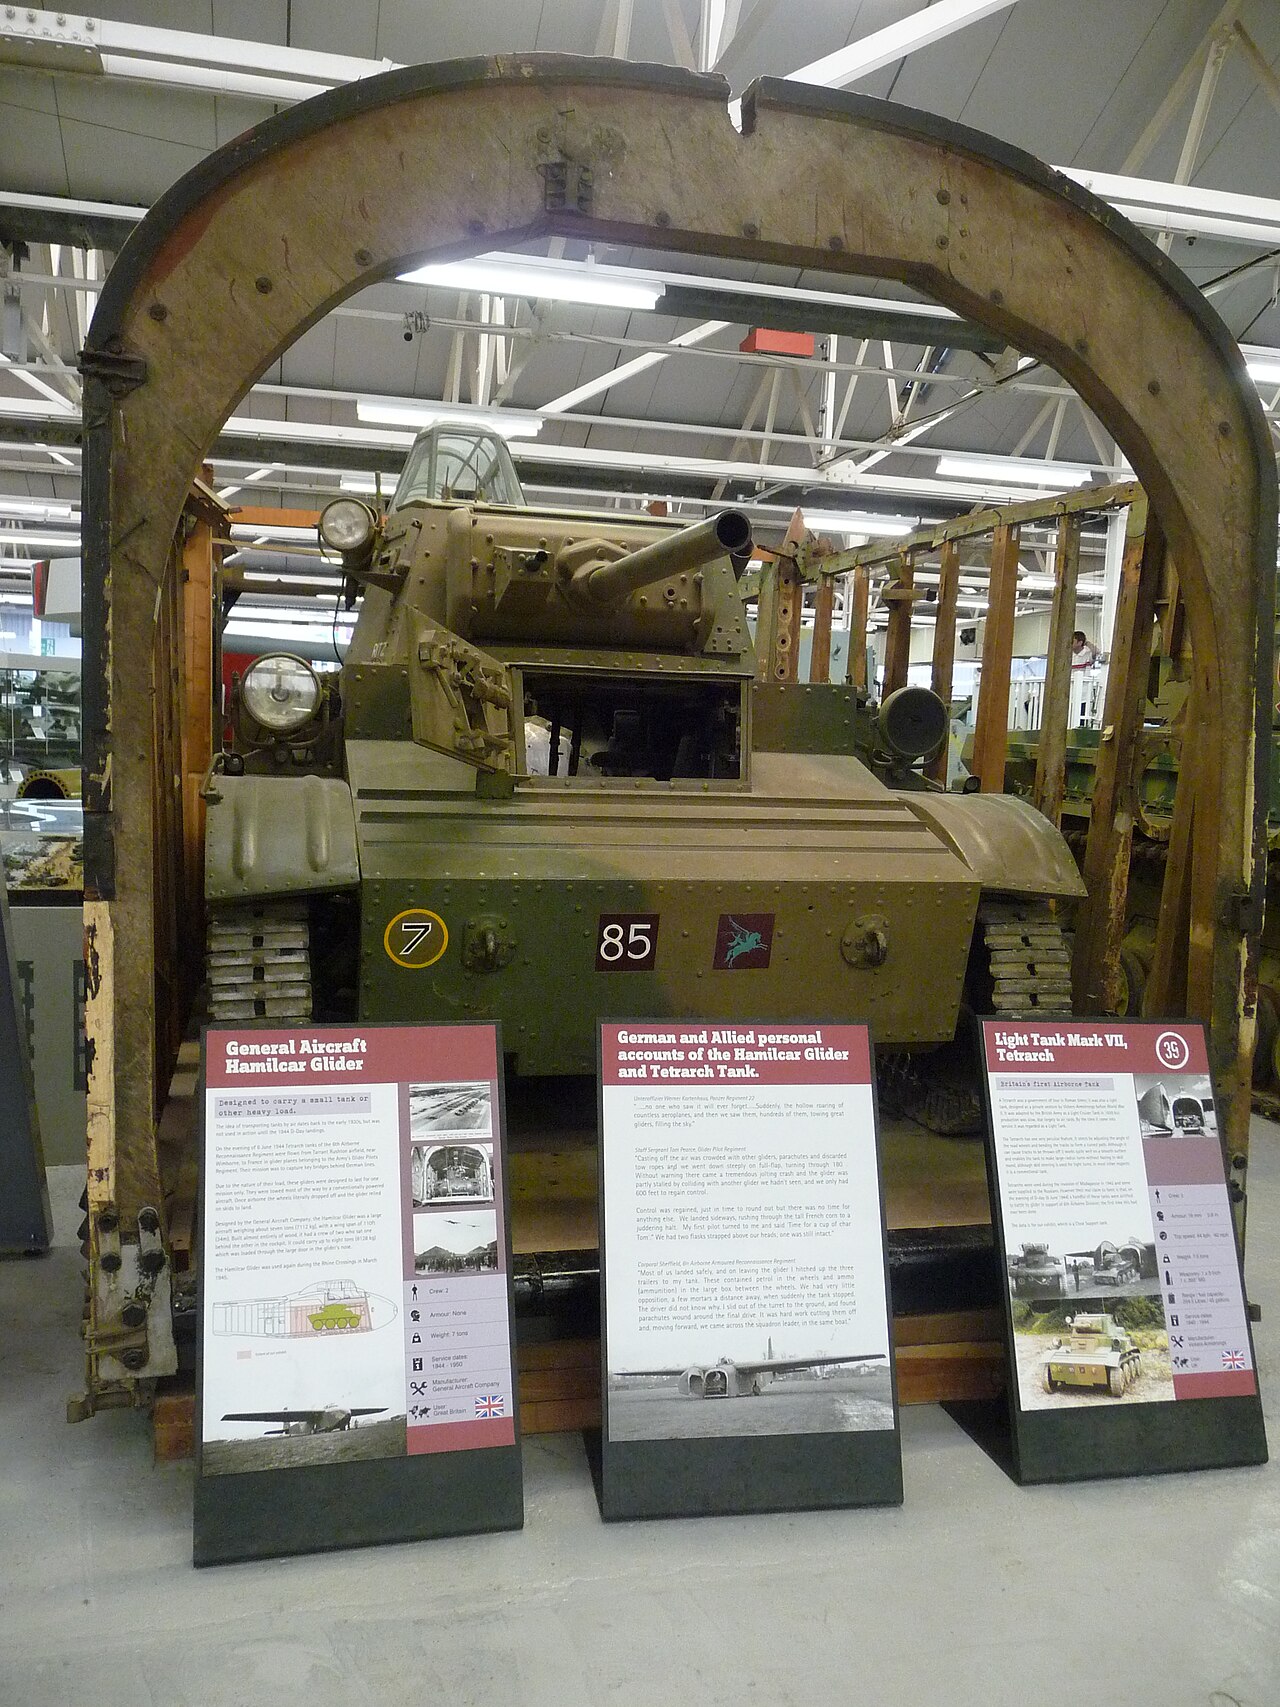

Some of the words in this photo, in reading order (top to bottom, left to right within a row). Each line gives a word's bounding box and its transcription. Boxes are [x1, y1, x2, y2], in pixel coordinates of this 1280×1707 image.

[400, 922, 432, 956] 7
[600, 924, 651, 961] 85
[618, 1031, 676, 1043] German
[680, 1031, 708, 1043] and
[711, 1031, 755, 1043] Allied
[758, 1031, 822, 1047] personal
[995, 1032, 1028, 1049] Light
[1031, 1033, 1065, 1046] Tank
[1067, 1034, 1103, 1046] Mark
[1104, 1035, 1127, 1049] VII,
[226, 1040, 295, 1055] General
[300, 1038, 366, 1053] Aircraft
[618, 1049, 684, 1060] accounts
[688, 1048, 704, 1060] of
[708, 1048, 730, 1060] the
[734, 1048, 801, 1060] Hamilcar
[804, 1048, 848, 1060] Glider
[997, 1049, 1054, 1061] Tetrarch
[226, 1058, 306, 1073] Hamilcar
[311, 1056, 363, 1071] Glider
[619, 1065, 647, 1077] and
[650, 1065, 714, 1077] Tetrarch
[717, 1065, 759, 1077] Tank.
[219, 1098, 256, 1108] Designed
[260, 1097, 269, 1105] to
[272, 1098, 297, 1106] carry
[309, 1095, 332, 1103] small
[218, 1108, 242, 1116] other
[246, 1107, 271, 1117] heavy
[474, 1381, 499, 1390] Company
[449, 1407, 466, 1415] Britain
